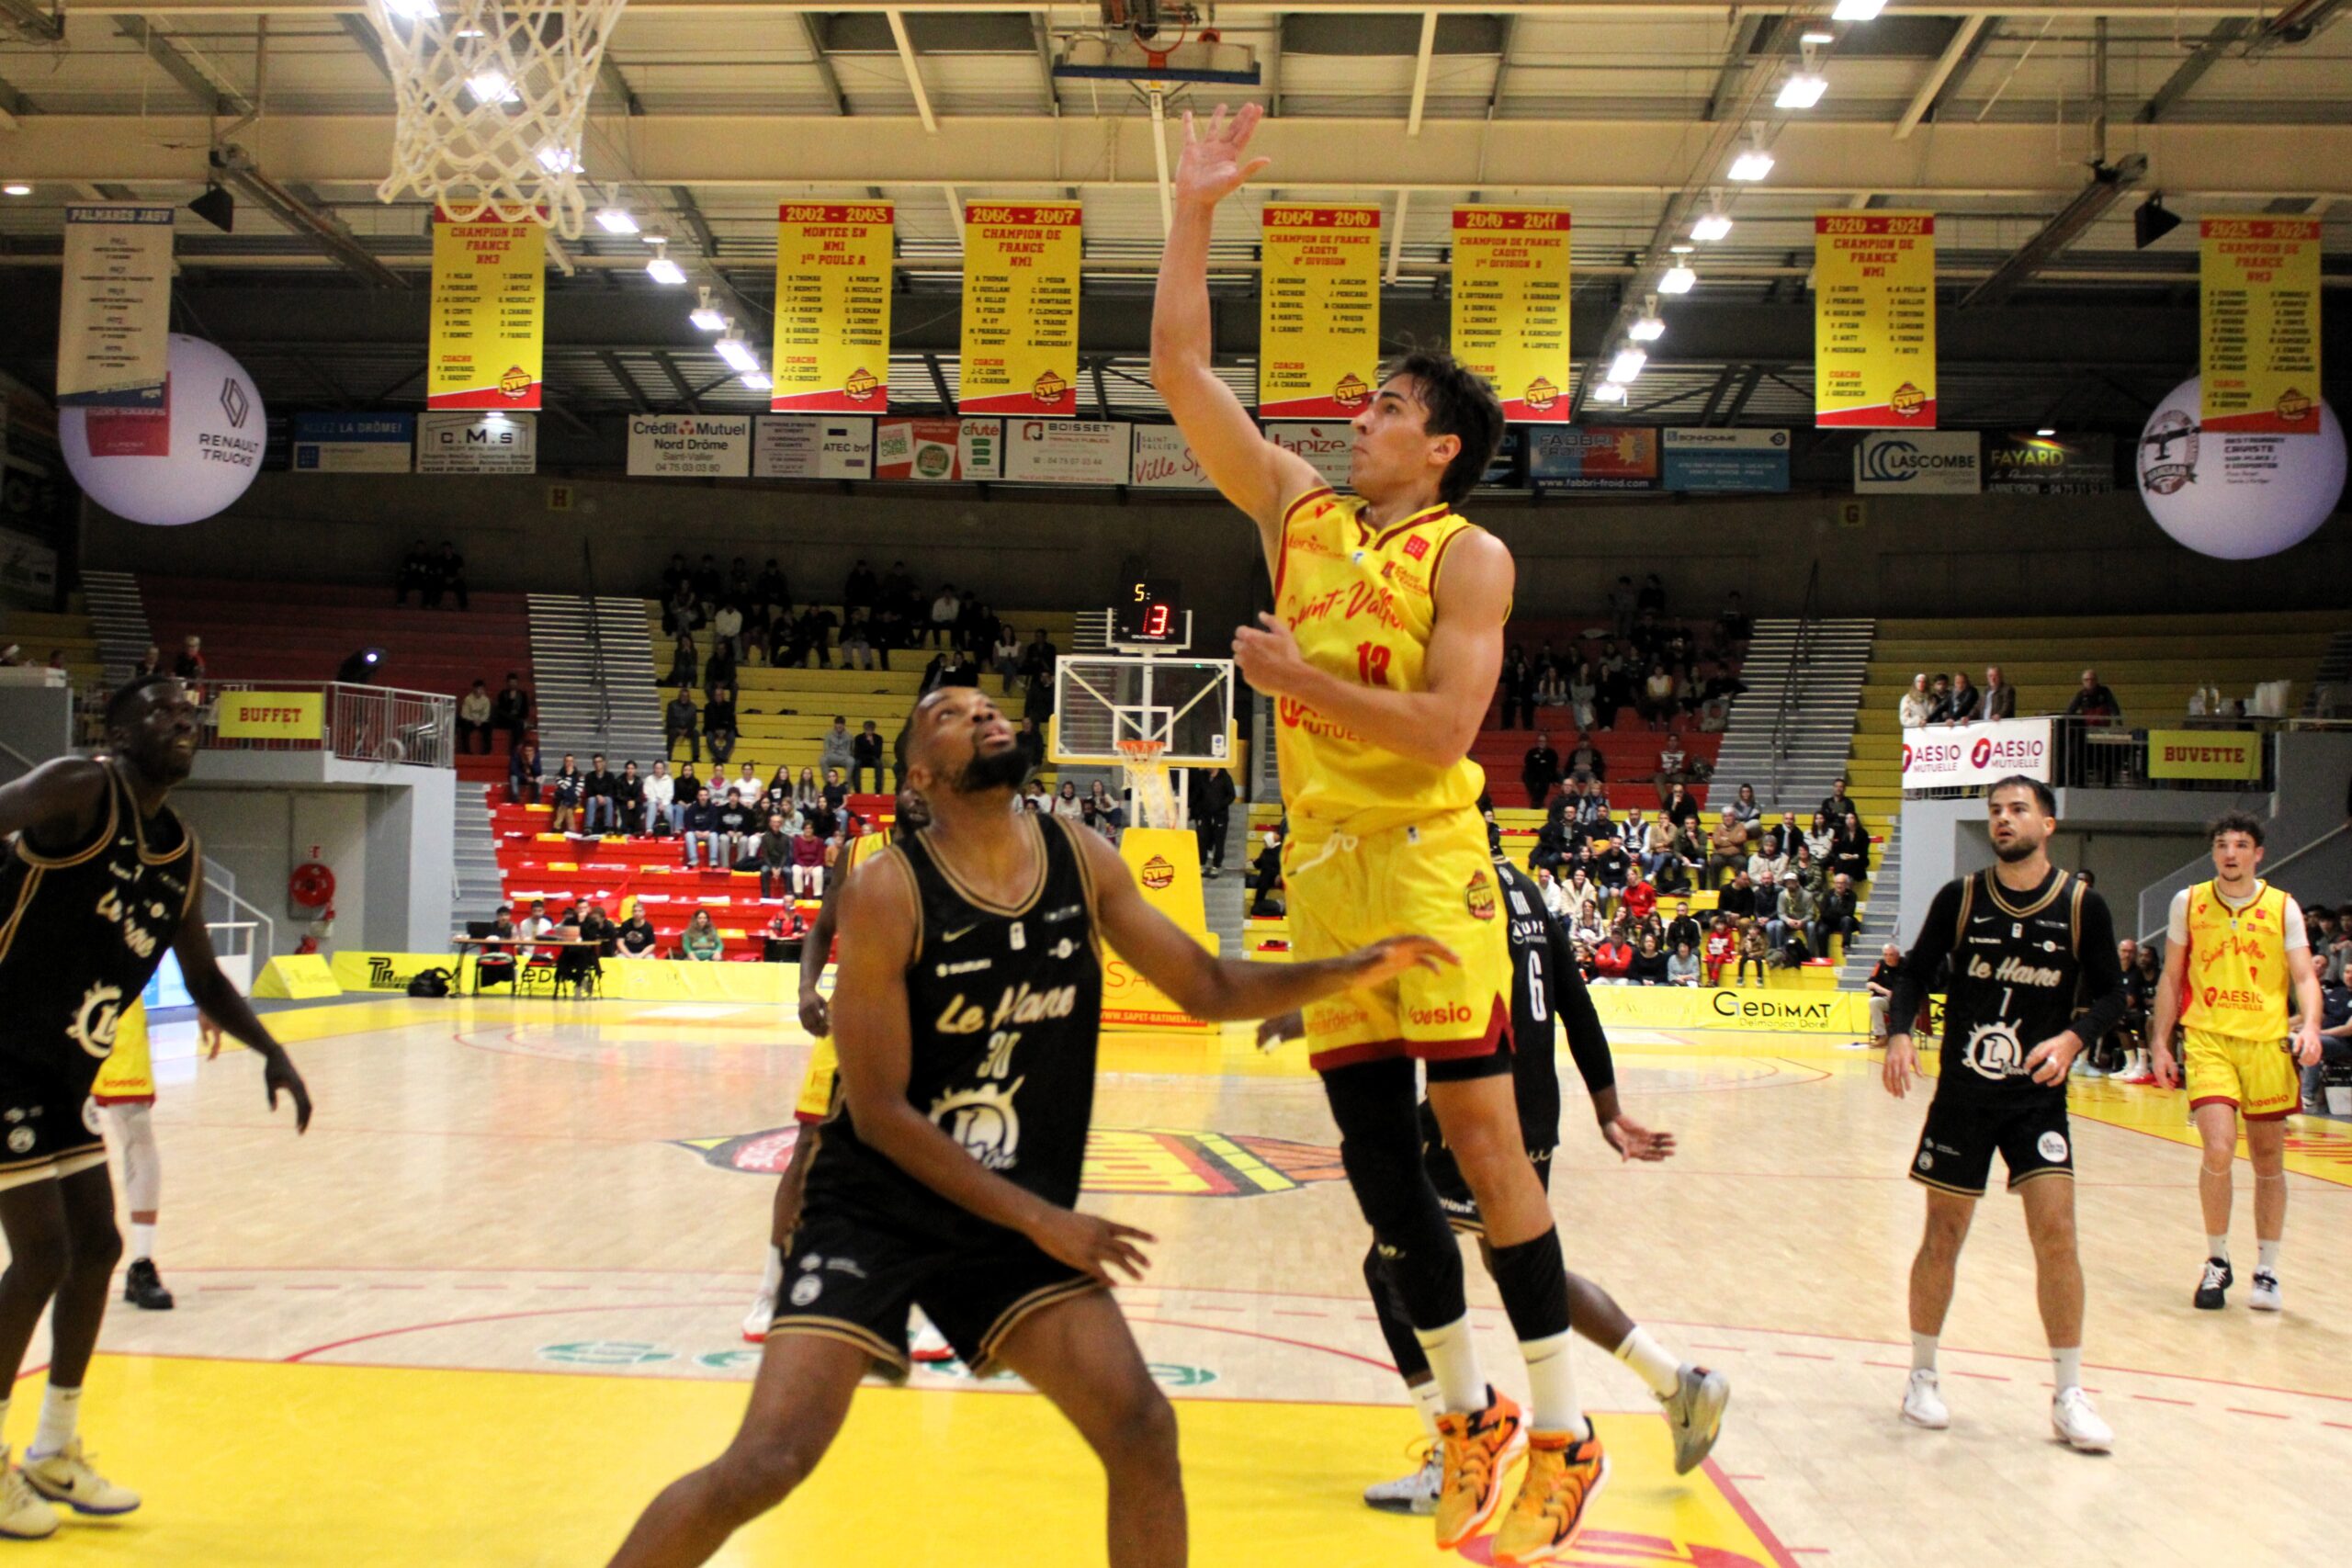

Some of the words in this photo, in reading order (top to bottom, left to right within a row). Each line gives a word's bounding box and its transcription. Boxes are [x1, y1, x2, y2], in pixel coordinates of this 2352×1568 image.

[786, 207, 826, 221] 2002
[846, 208, 888, 222] 2003
[973, 208, 1013, 222] 2006
[1034, 209, 1075, 224] 2007
[1272, 210, 1314, 225] 2009
[1334, 211, 1371, 226] 2010
[1466, 213, 1503, 228] 2010
[1523, 214, 1558, 229] 2011
[1826, 218, 1867, 232] 2020
[451, 228, 509, 237] CHAMPION
[512, 228, 526, 237] DE
[852, 228, 867, 238] EN
[983, 229, 1043, 239] CHAMPION
[1046, 230, 1061, 240] DE
[466, 241, 511, 250] FRANCE
[1270, 235, 1317, 243] CHAMPION
[1320, 235, 1331, 243] DE
[1335, 235, 1371, 244] FRANCE
[1460, 237, 1507, 245] CHAMPION
[1510, 237, 1521, 245] DE
[1525, 238, 1561, 247] FRANCE
[1834, 239, 1895, 249] CHAMPION
[1899, 239, 1915, 250] DE
[999, 243, 1045, 253] FRANCE
[1302, 246, 1338, 254] CADETS
[819, 254, 855, 265] POULE
[858, 255, 866, 265] A
[1850, 253, 1897, 263] FRANCE
[340, 423, 354, 433] LA
[633, 422, 677, 435] Crédit
[696, 423, 746, 436] Mutuel
[1048, 423, 1110, 433] BOISSET
[198, 434, 259, 454] RENAULT
[654, 439, 684, 450] Nord
[687, 438, 729, 451] Drôme
[823, 443, 851, 452] ATEC
[202, 448, 254, 467] TRUCKS
[1891, 455, 1975, 469] LASCOMBE
[1990, 450, 2064, 468] FAYARD
[1136, 457, 1176, 484] Ville
[1538, 478, 1649, 489] www.fabbri-froid.com
[553, 490, 567, 506] H
[240, 707, 301, 723] BUFFET
[2164, 746, 2245, 763] BUVETTE
[1913, 762, 1958, 773] MUTUELLE
[1991, 759, 2040, 768] MUTUELLE
[1968, 953, 1991, 979] Le
[1996, 956, 2061, 987] Havre
[1528, 950, 1547, 1021] 6
[1999, 987, 2013, 1018] 1
[936, 994, 985, 1034] Le
